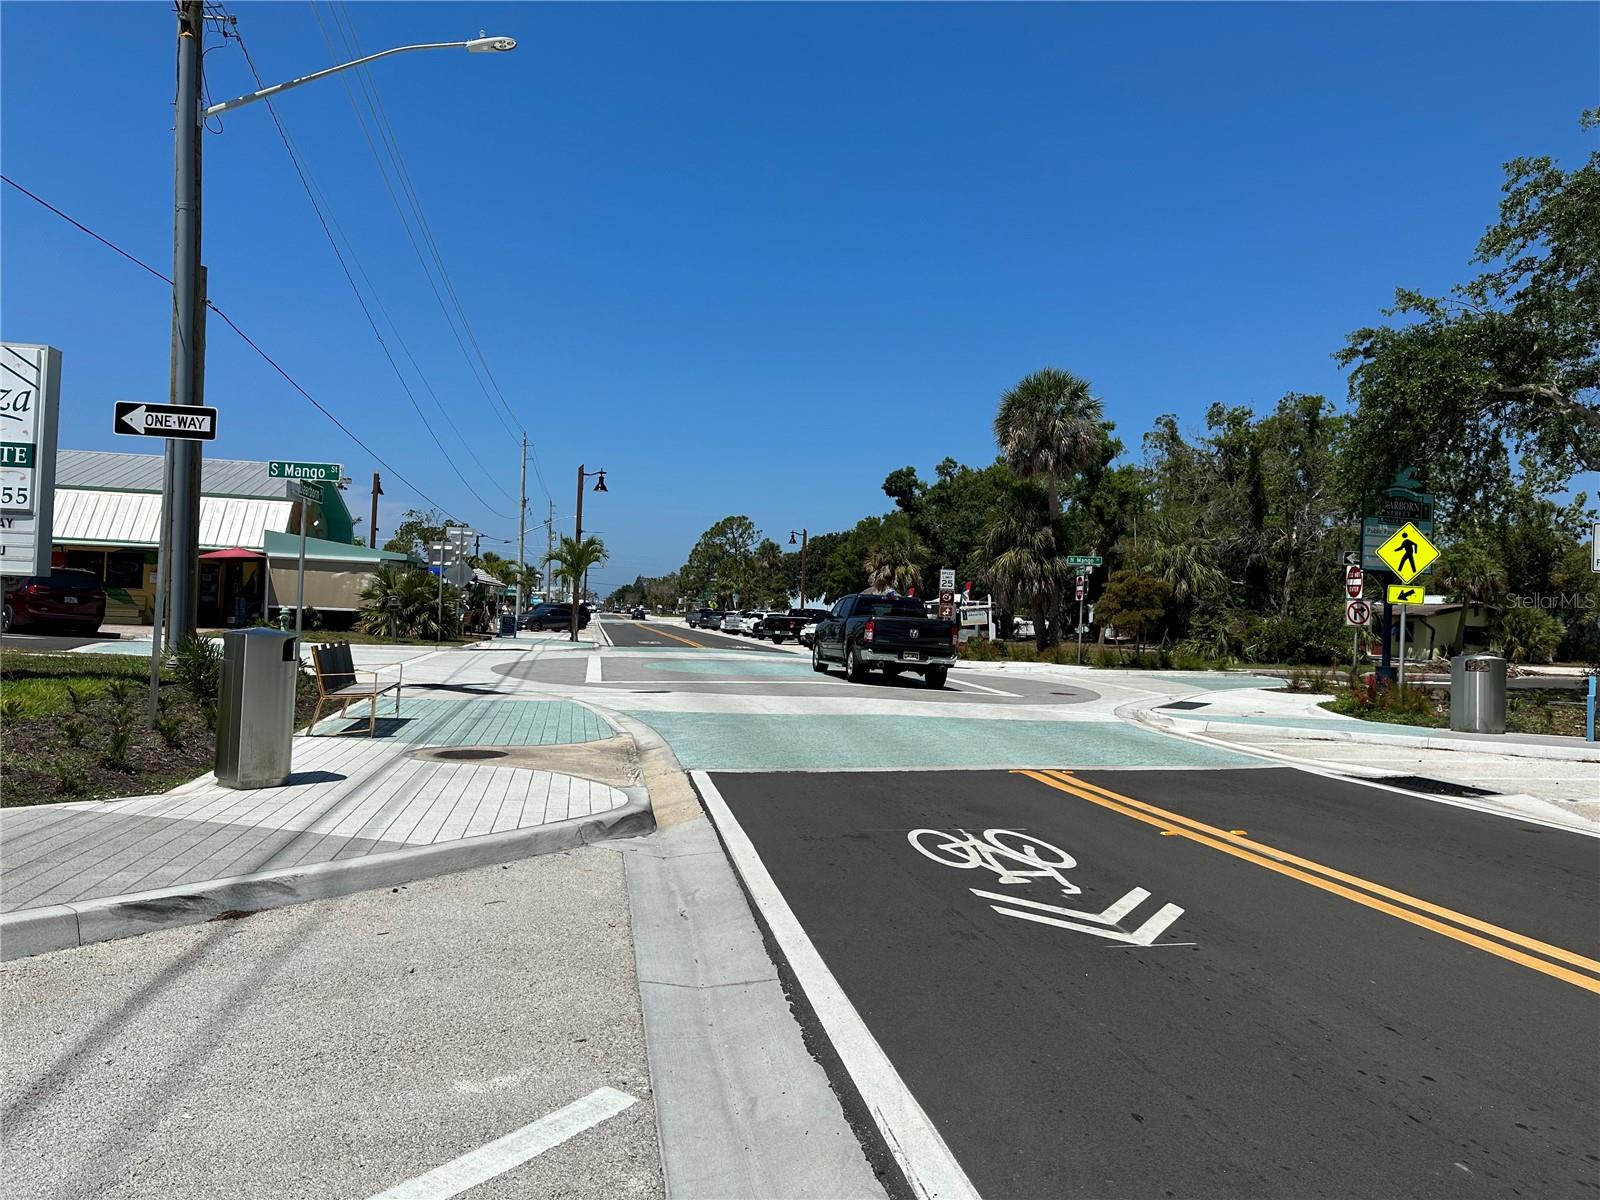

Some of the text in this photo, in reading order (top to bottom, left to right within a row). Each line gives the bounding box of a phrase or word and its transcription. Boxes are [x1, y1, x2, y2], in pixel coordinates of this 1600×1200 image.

[145, 414, 205, 430] ONE WAY
[270, 463, 278, 476] S
[284, 464, 326, 479] Mango
